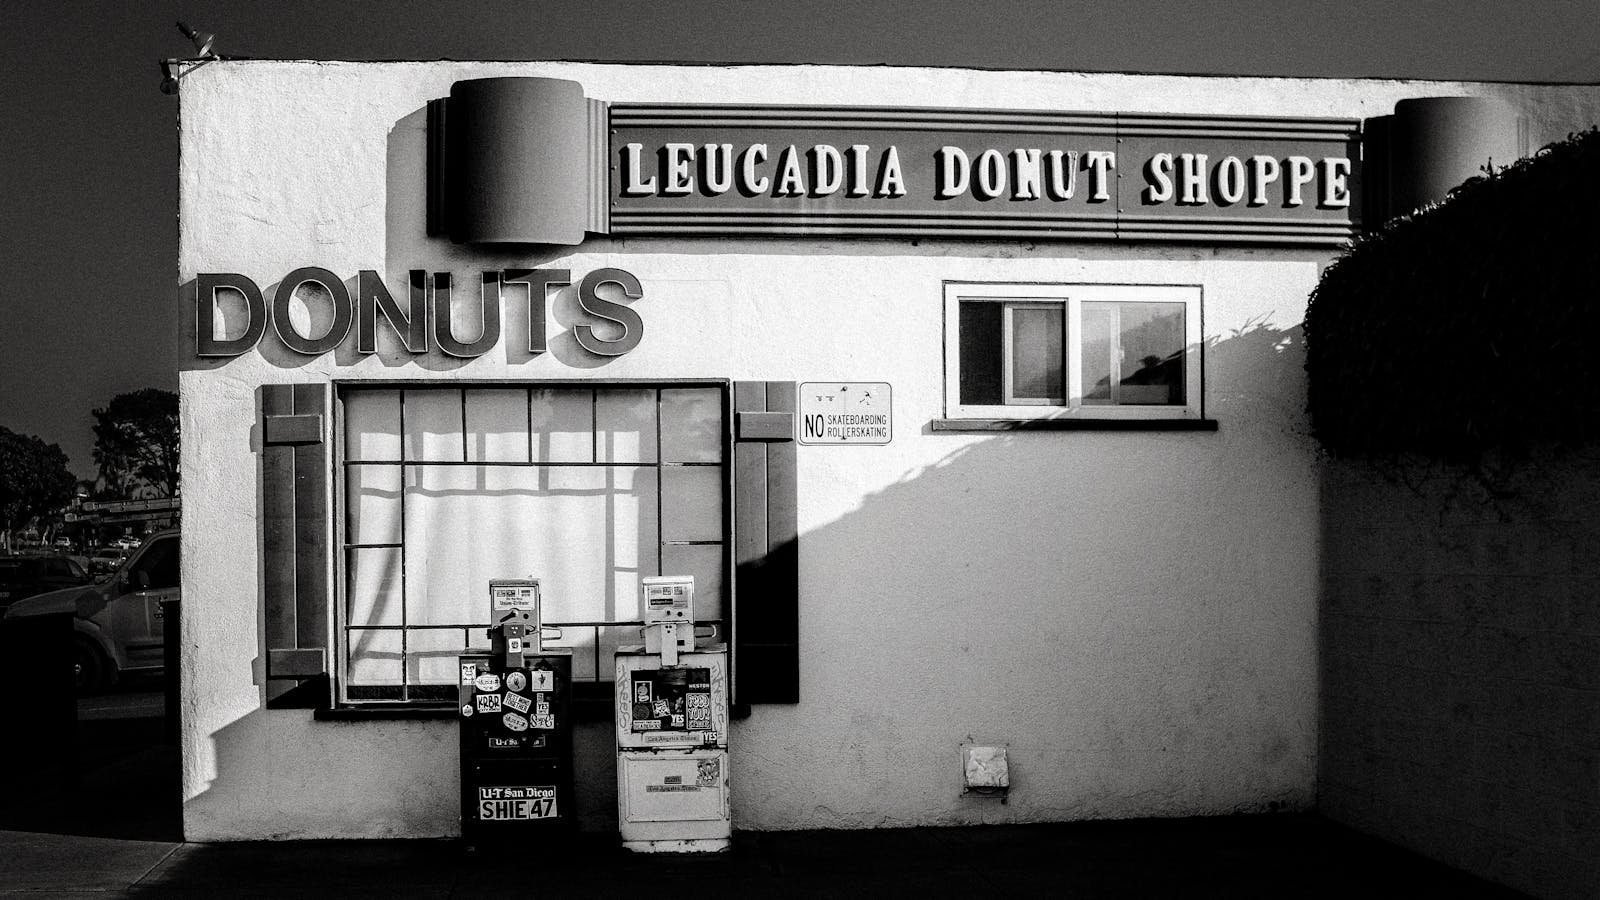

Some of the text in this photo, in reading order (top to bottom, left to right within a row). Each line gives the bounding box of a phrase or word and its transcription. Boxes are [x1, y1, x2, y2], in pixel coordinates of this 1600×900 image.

[622, 142, 1351, 207] LEUCADIA DONUT SHOPPE
[196, 266, 644, 357] DONUTS
[805, 414, 887, 438] NO SKATEBOARDING
[827, 427, 887, 438] ROLLERSKATING
[478, 695, 500, 709] KRBR
[671, 714, 684, 723] YES
[704, 732, 717, 741] YES
[482, 788, 554, 799] U-T San Diego
[482, 798, 555, 819] SHIE 47
